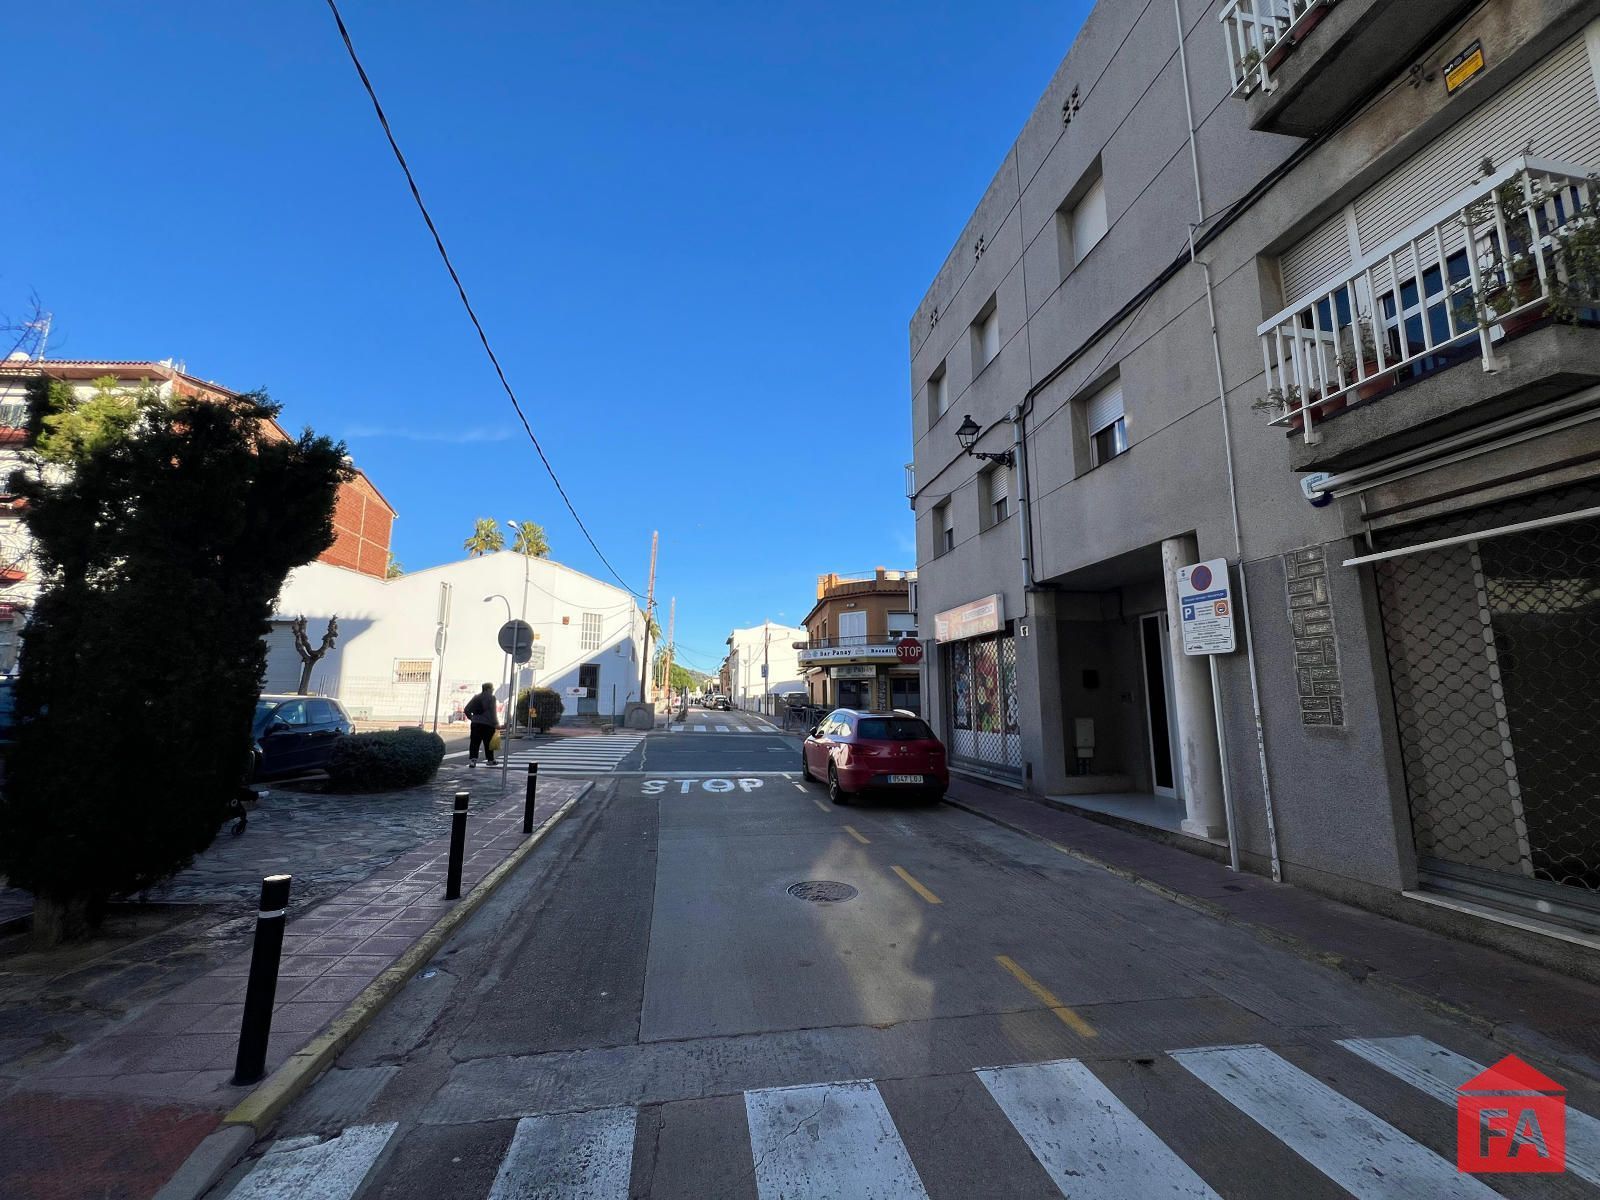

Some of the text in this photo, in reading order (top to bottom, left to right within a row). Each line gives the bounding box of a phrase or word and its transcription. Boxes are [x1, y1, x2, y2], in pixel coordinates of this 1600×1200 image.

[1184, 608, 1192, 619] P
[897, 646, 922, 657] STOP
[641, 778, 764, 794] STOP
